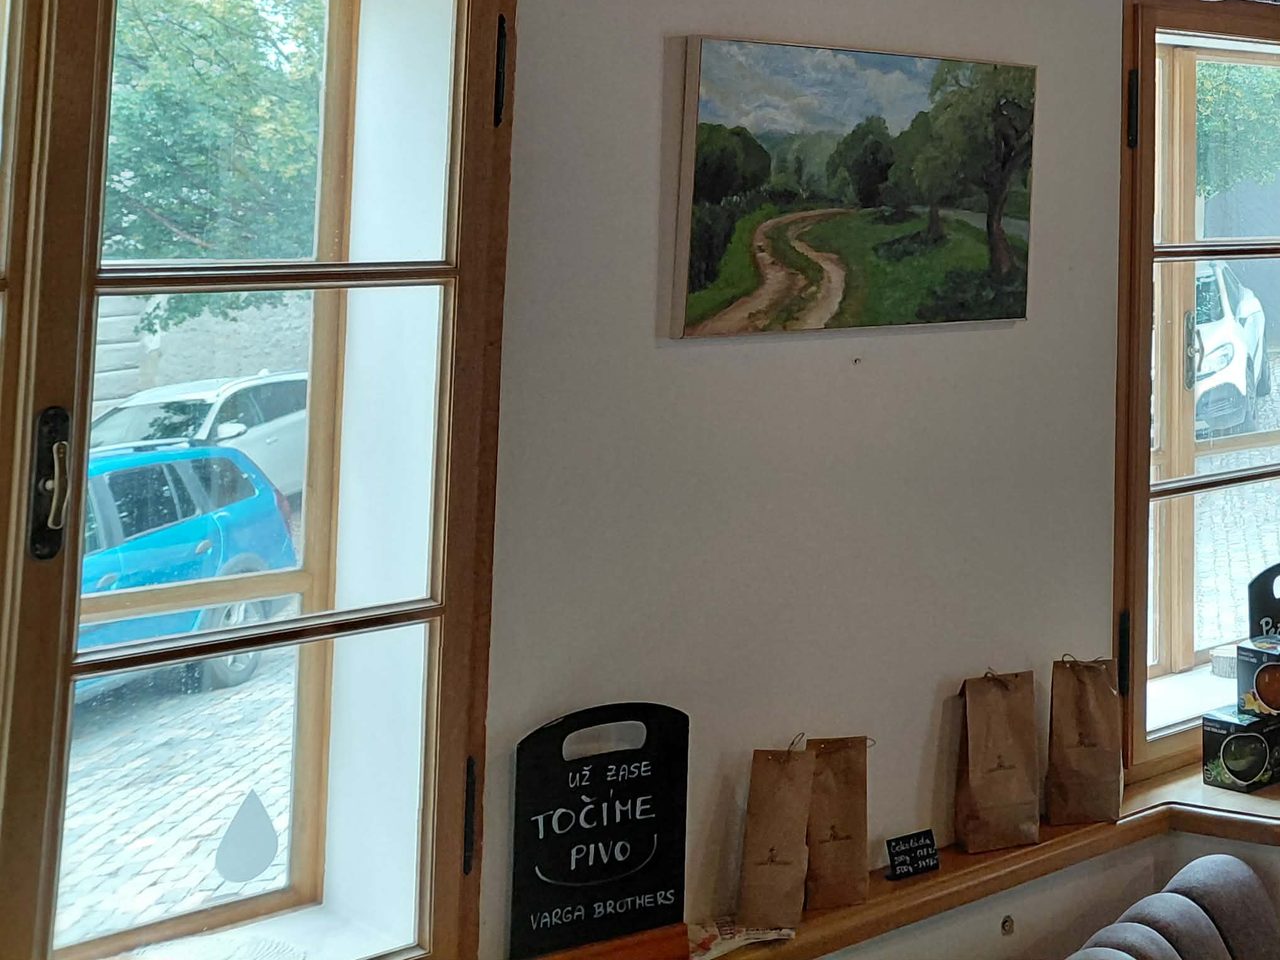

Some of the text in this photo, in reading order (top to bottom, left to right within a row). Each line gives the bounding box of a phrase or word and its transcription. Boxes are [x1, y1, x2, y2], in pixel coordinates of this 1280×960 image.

[568, 761, 652, 788] UŽ ZASE
[530, 789, 656, 839] TOČÍME
[570, 841, 631, 870] PIVO
[530, 890, 675, 930] VARGA BROTHERS
